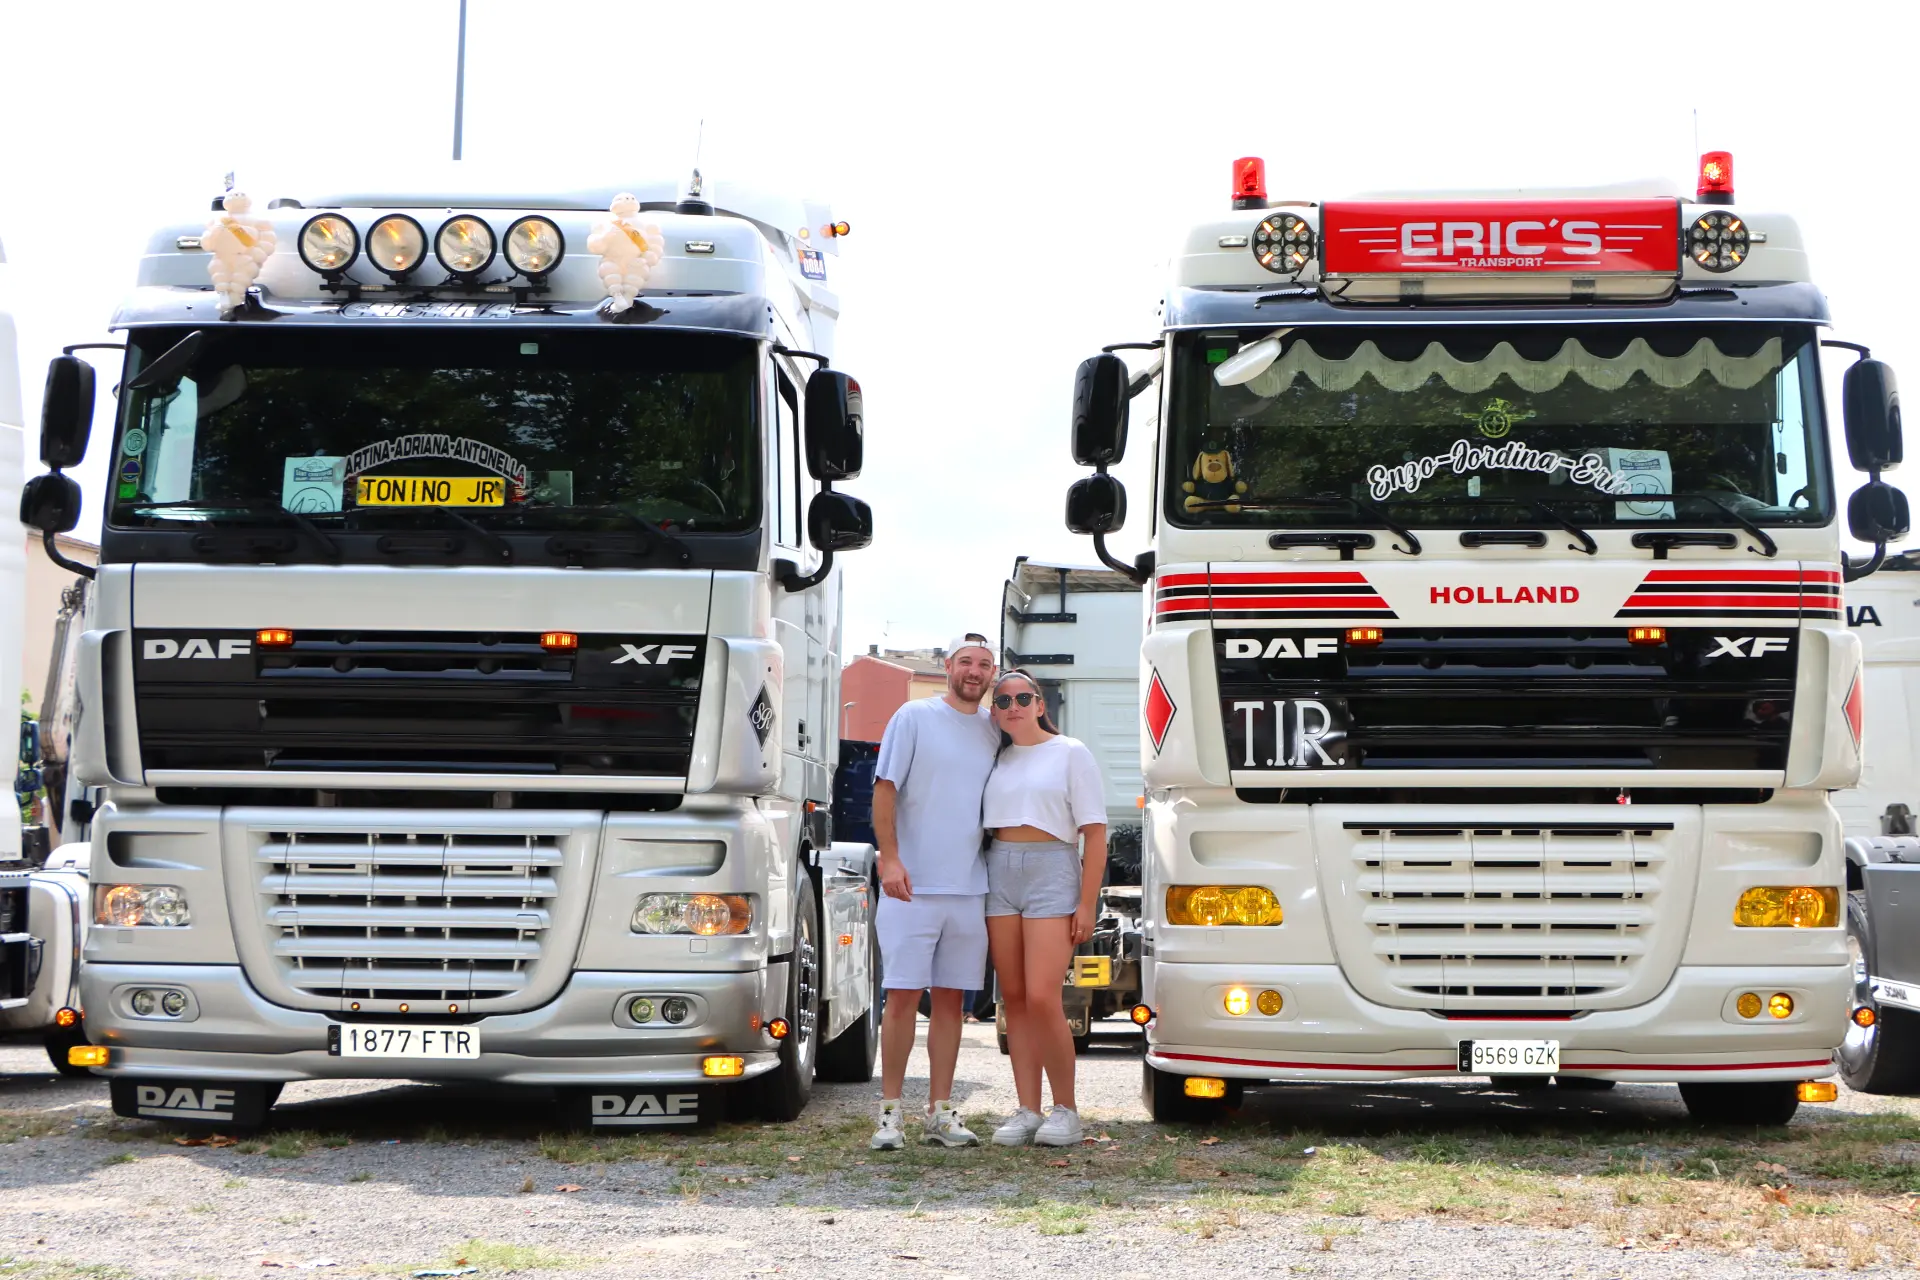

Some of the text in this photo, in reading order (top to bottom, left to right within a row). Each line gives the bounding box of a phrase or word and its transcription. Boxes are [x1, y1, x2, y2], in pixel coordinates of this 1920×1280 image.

[1401, 218, 1602, 256] ERIC'S
[1460, 257, 1543, 267] TRANSPORT
[363, 479, 451, 502] TONINO
[1430, 586, 1580, 604] HOLLAND
[144, 638, 251, 659] DAF
[610, 644, 697, 665] XF
[1225, 638, 1338, 659] DAF
[1704, 636, 1790, 657] XF
[1233, 700, 1346, 767] T.I.R.
[331, 1029, 471, 1054] E 1877 FTR
[1474, 1047, 1518, 1065] 9569
[1524, 1047, 1556, 1065] GZK
[137, 1085, 235, 1110] DAF
[592, 1094, 698, 1115] DAF
